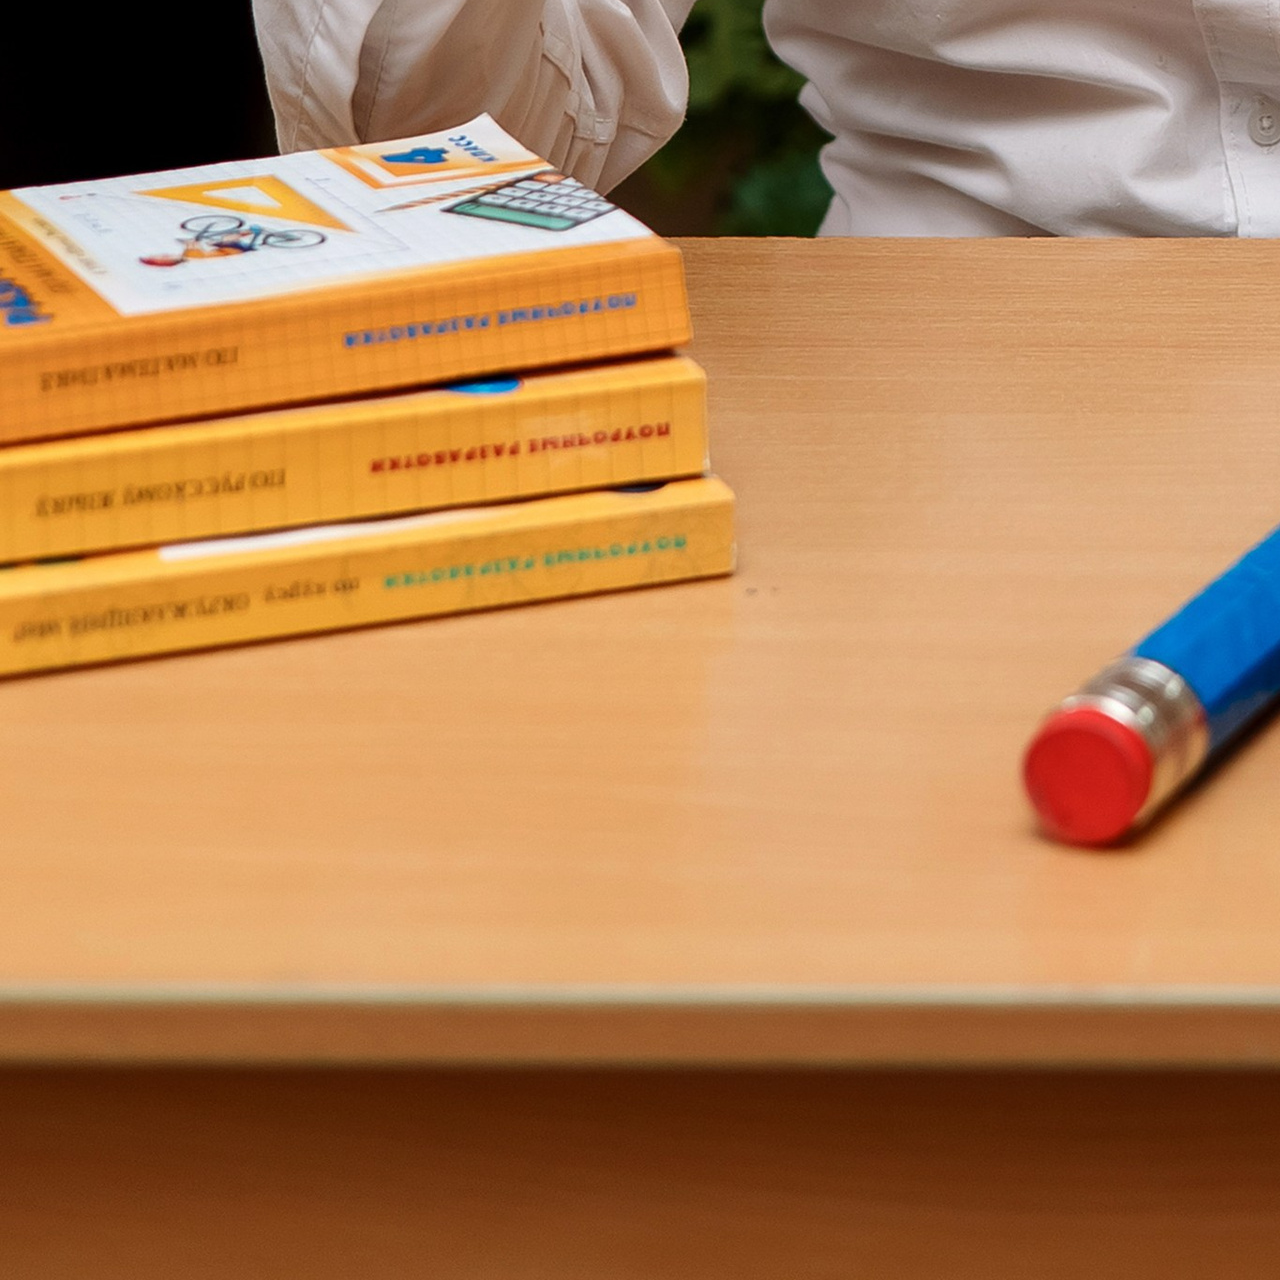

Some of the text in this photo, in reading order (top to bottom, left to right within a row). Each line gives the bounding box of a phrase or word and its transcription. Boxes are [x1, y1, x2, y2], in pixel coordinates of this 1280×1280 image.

[380, 145, 449, 166] 4
[449, 134, 497, 163] КЛАСС
[344, 294, 637, 347] ПОУРОЧНЫЕ РАЗРАБОТКИ
[39, 346, 239, 392] ПО МАТЕМАТИКЕ
[369, 421, 672, 474] ПОУРОЧНЫЕ РАЗРАБОТКИ
[121, 469, 247, 506] РУССКОМУ
[382, 535, 688, 590] ПОУРОЧНЫЕ РАЗРАБОТКИ
